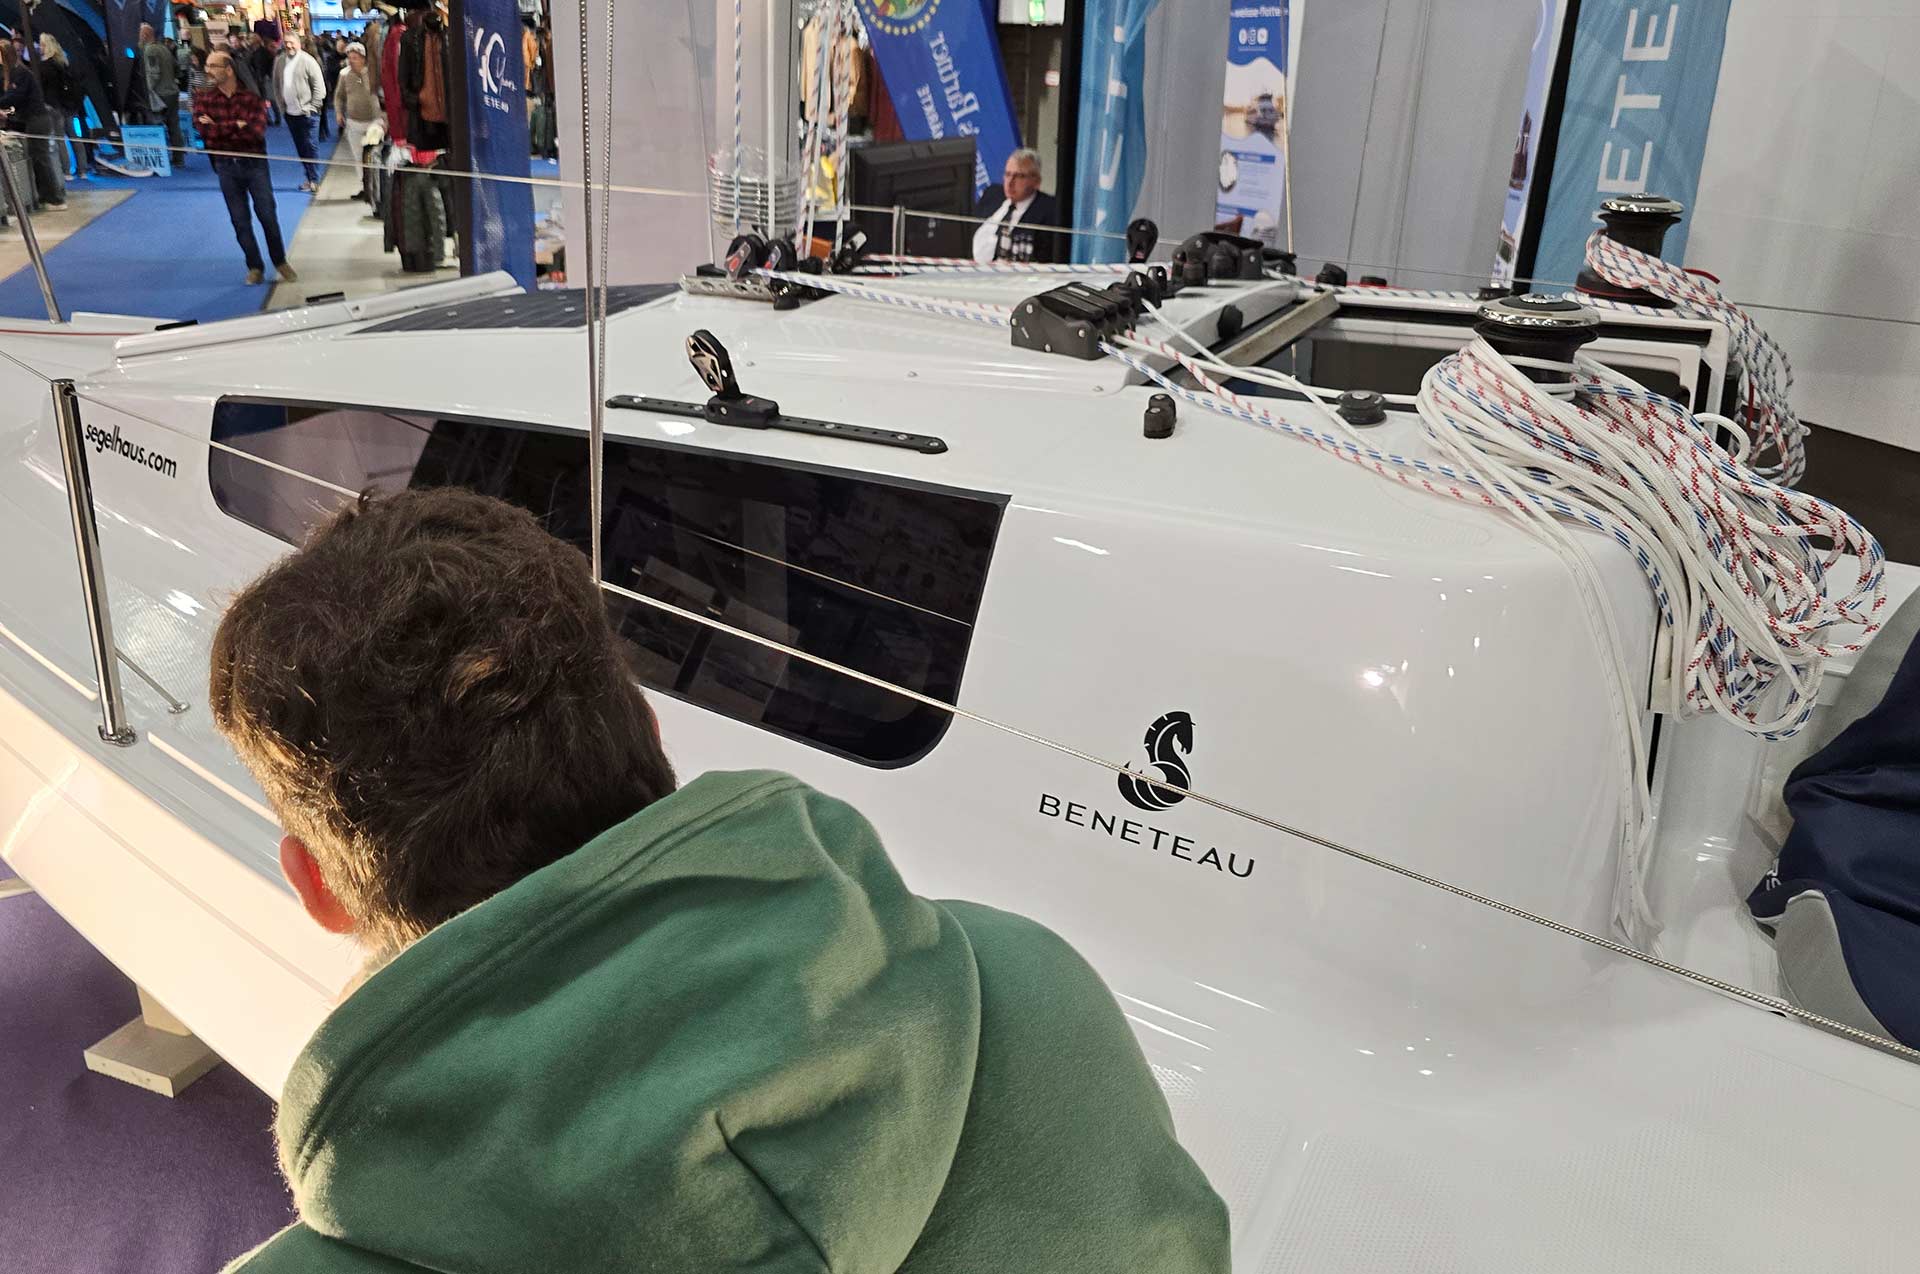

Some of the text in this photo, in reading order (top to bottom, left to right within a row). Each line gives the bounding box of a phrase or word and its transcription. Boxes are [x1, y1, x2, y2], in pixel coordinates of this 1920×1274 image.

[1593, 3, 1679, 222] ETE
[85, 424, 177, 478] segelhaus.com
[1038, 793, 1255, 878] BENETEAU
